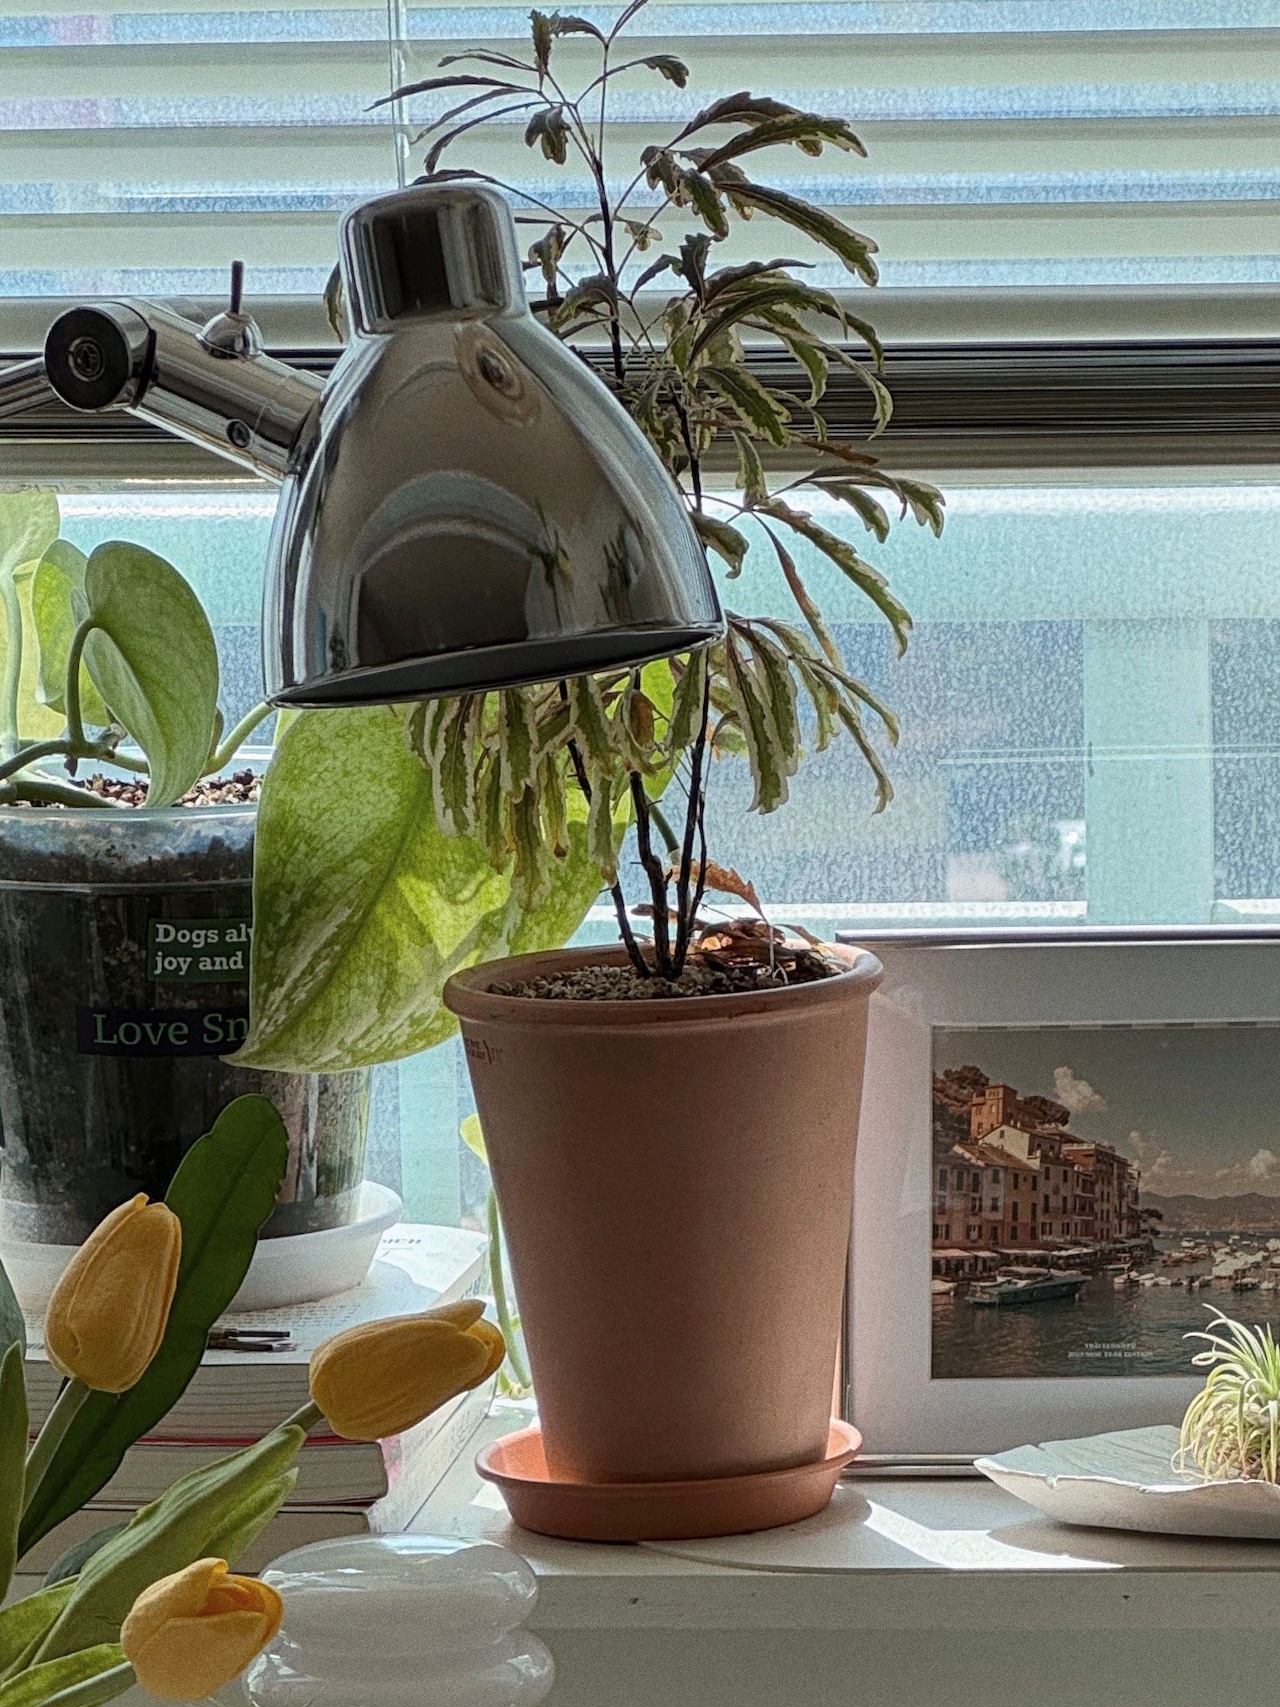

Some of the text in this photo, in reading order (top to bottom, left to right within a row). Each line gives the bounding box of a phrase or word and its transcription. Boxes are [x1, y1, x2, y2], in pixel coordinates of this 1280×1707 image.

[154, 923, 219, 948] Dogs
[153, 951, 244, 976] joy and
[92, 1013, 189, 1046] Love
